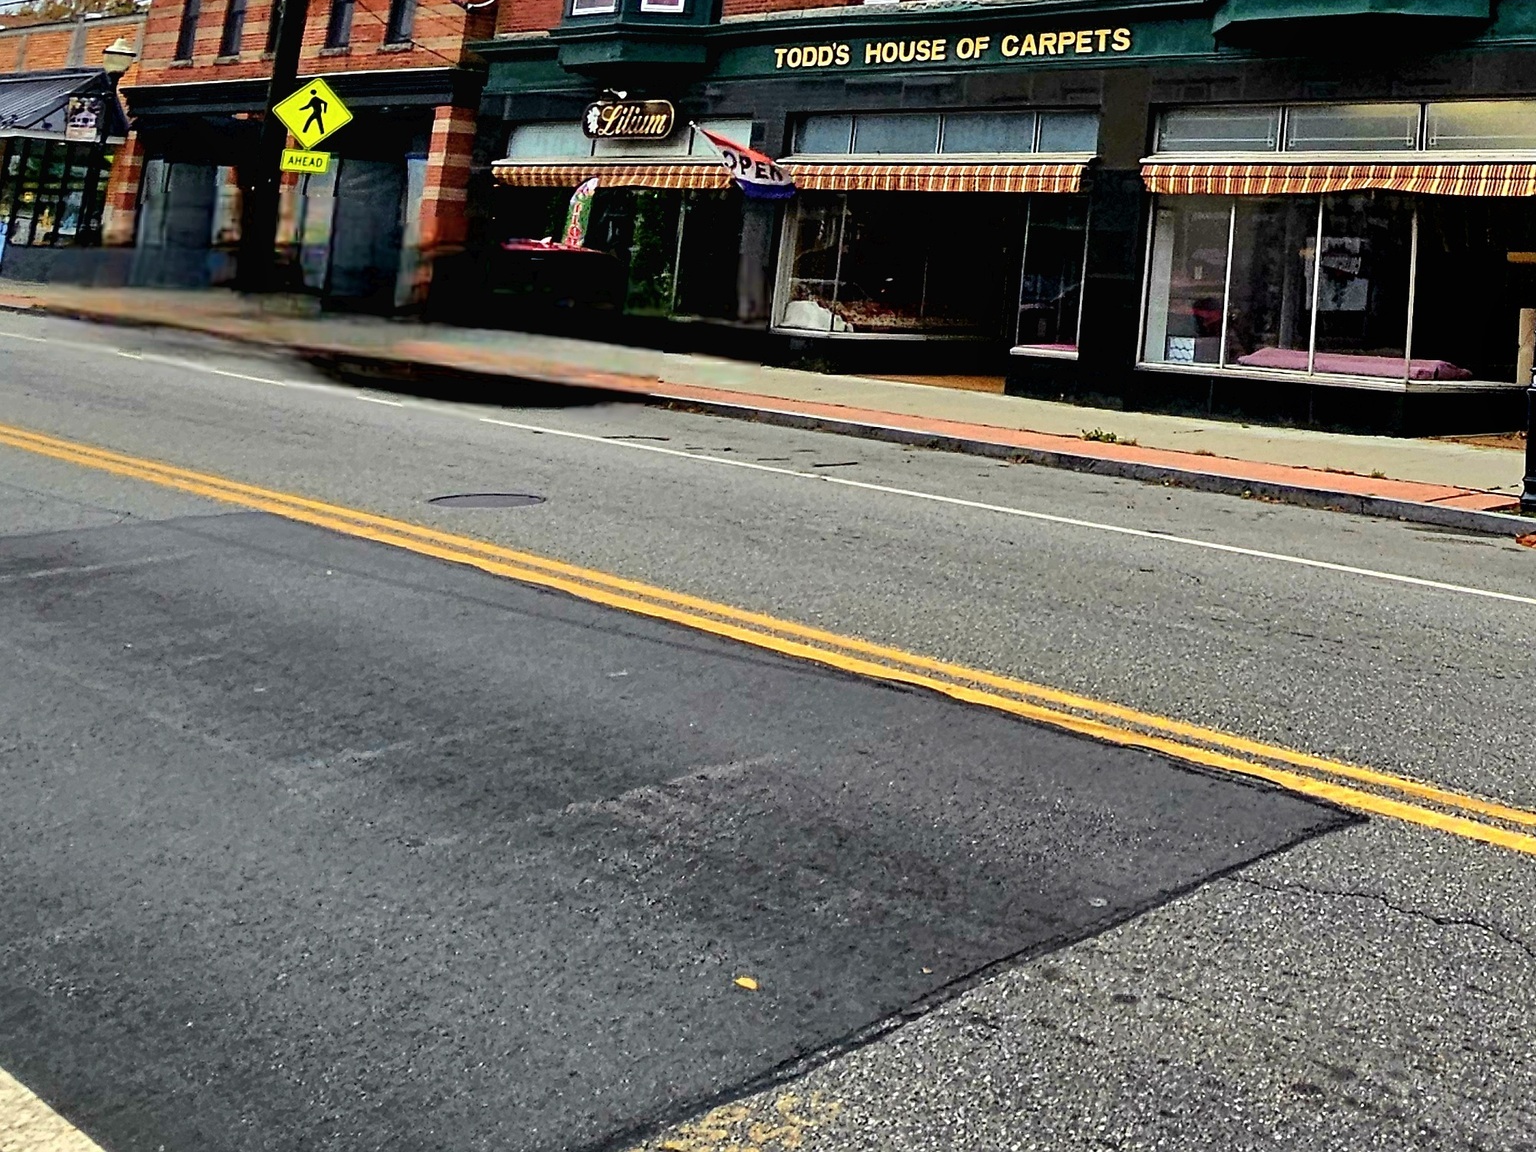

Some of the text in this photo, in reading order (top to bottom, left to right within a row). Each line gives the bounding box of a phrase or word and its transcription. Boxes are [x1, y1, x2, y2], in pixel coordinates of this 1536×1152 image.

[774, 27, 1132, 69] TODD'S HOUSE OF CARPETS
[598, 105, 668, 137] Lilium
[287, 156, 324, 168] AHEAD
[722, 150, 783, 182] OPEN
